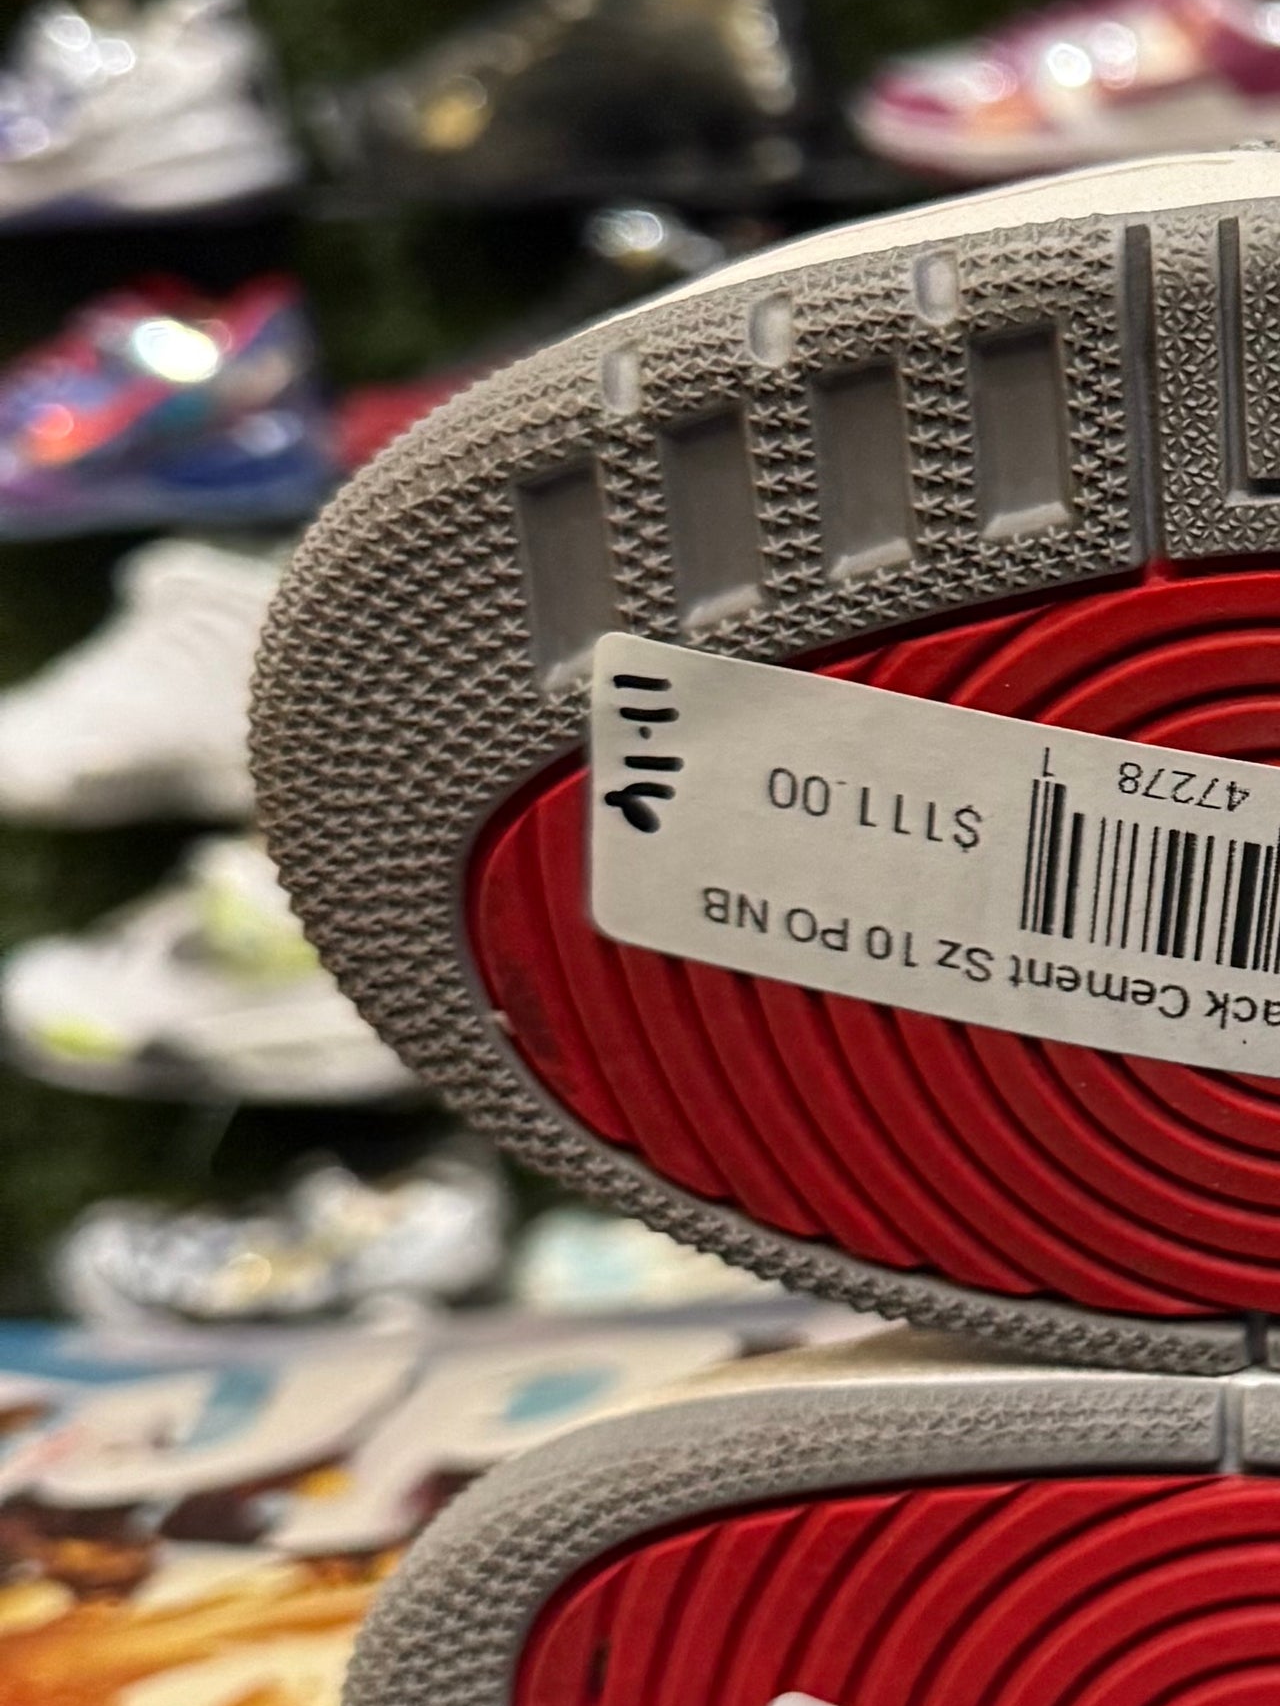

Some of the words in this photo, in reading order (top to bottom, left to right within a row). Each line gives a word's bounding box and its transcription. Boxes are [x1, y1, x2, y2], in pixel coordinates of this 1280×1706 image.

[1041, 745, 1056, 778] 1
[766, 766, 984, 854] $111.00
[1117, 761, 1251, 813] 47278
[700, 886, 769, 934] NB
[783, 907, 850, 953] PO
[864, 925, 919, 969] 10
[933, 938, 995, 983] Sz
[1006, 953, 1191, 1020] Cement
